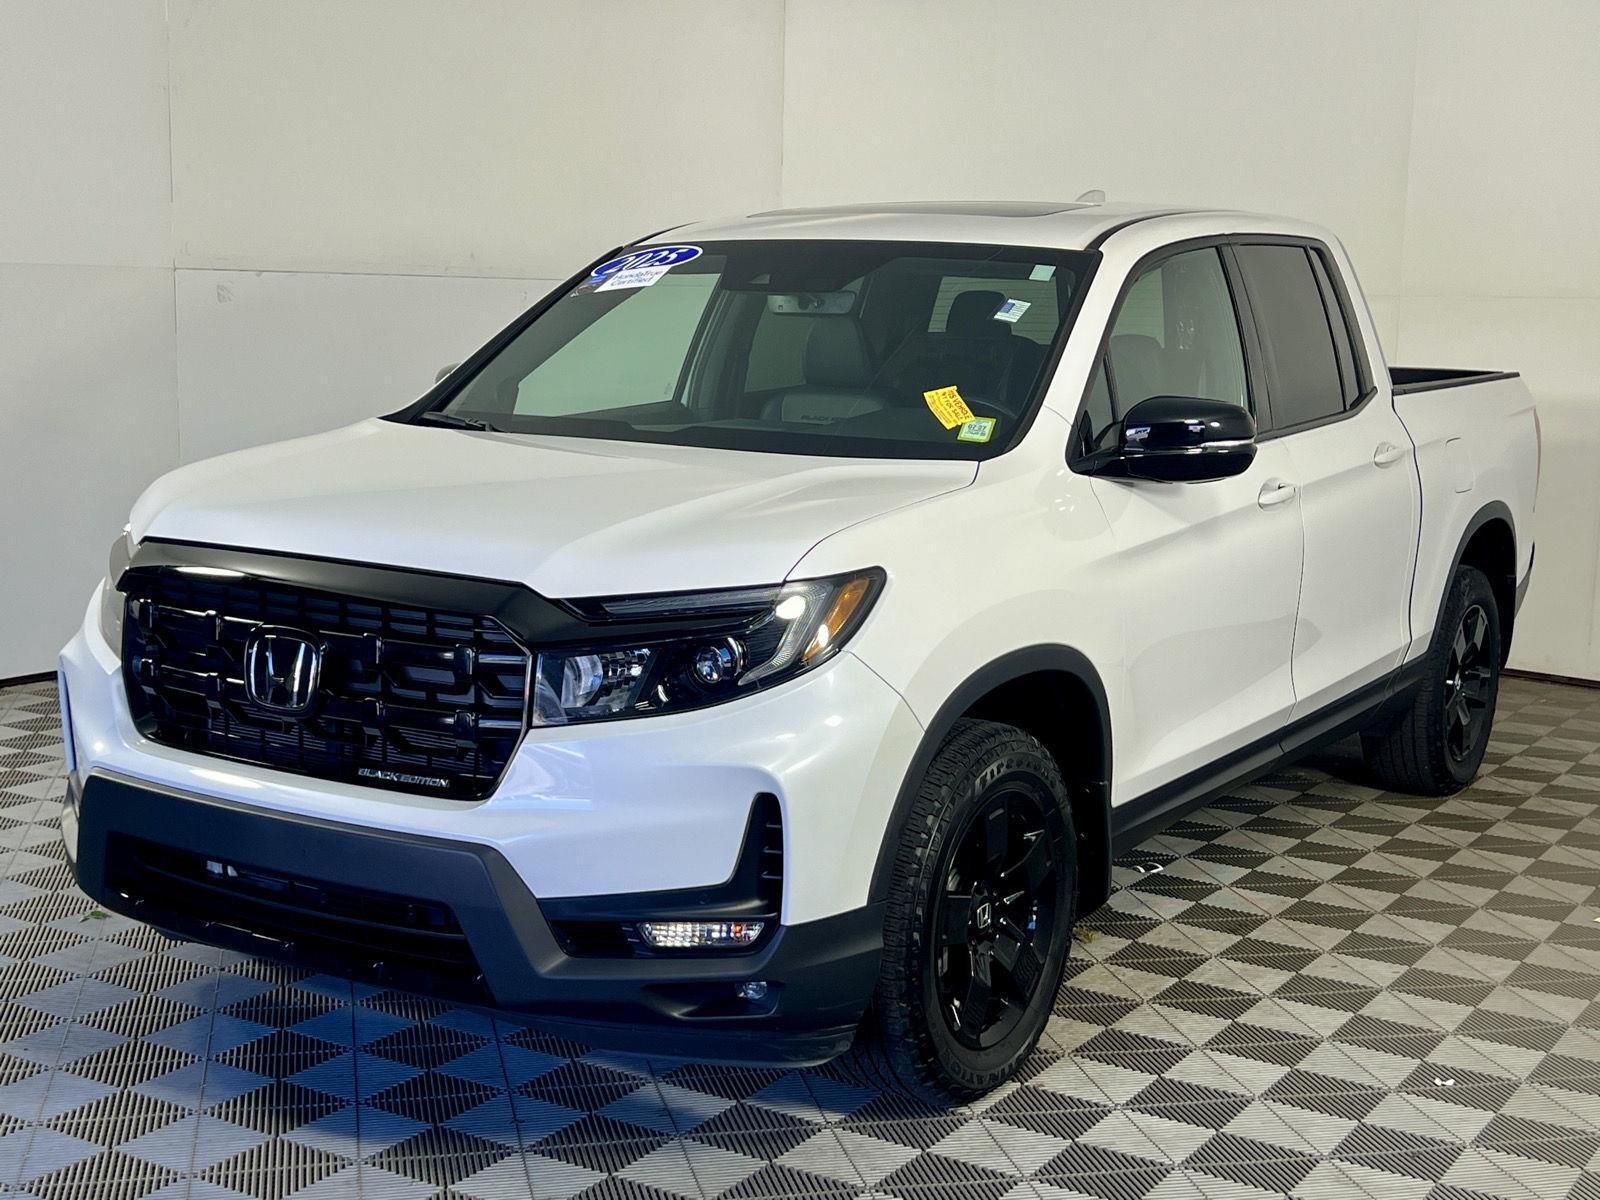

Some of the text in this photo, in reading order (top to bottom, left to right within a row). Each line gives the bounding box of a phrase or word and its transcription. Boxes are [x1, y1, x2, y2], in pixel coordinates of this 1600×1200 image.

[603, 249, 690, 275] 2025
[358, 768, 449, 787] BLACK EDITION
